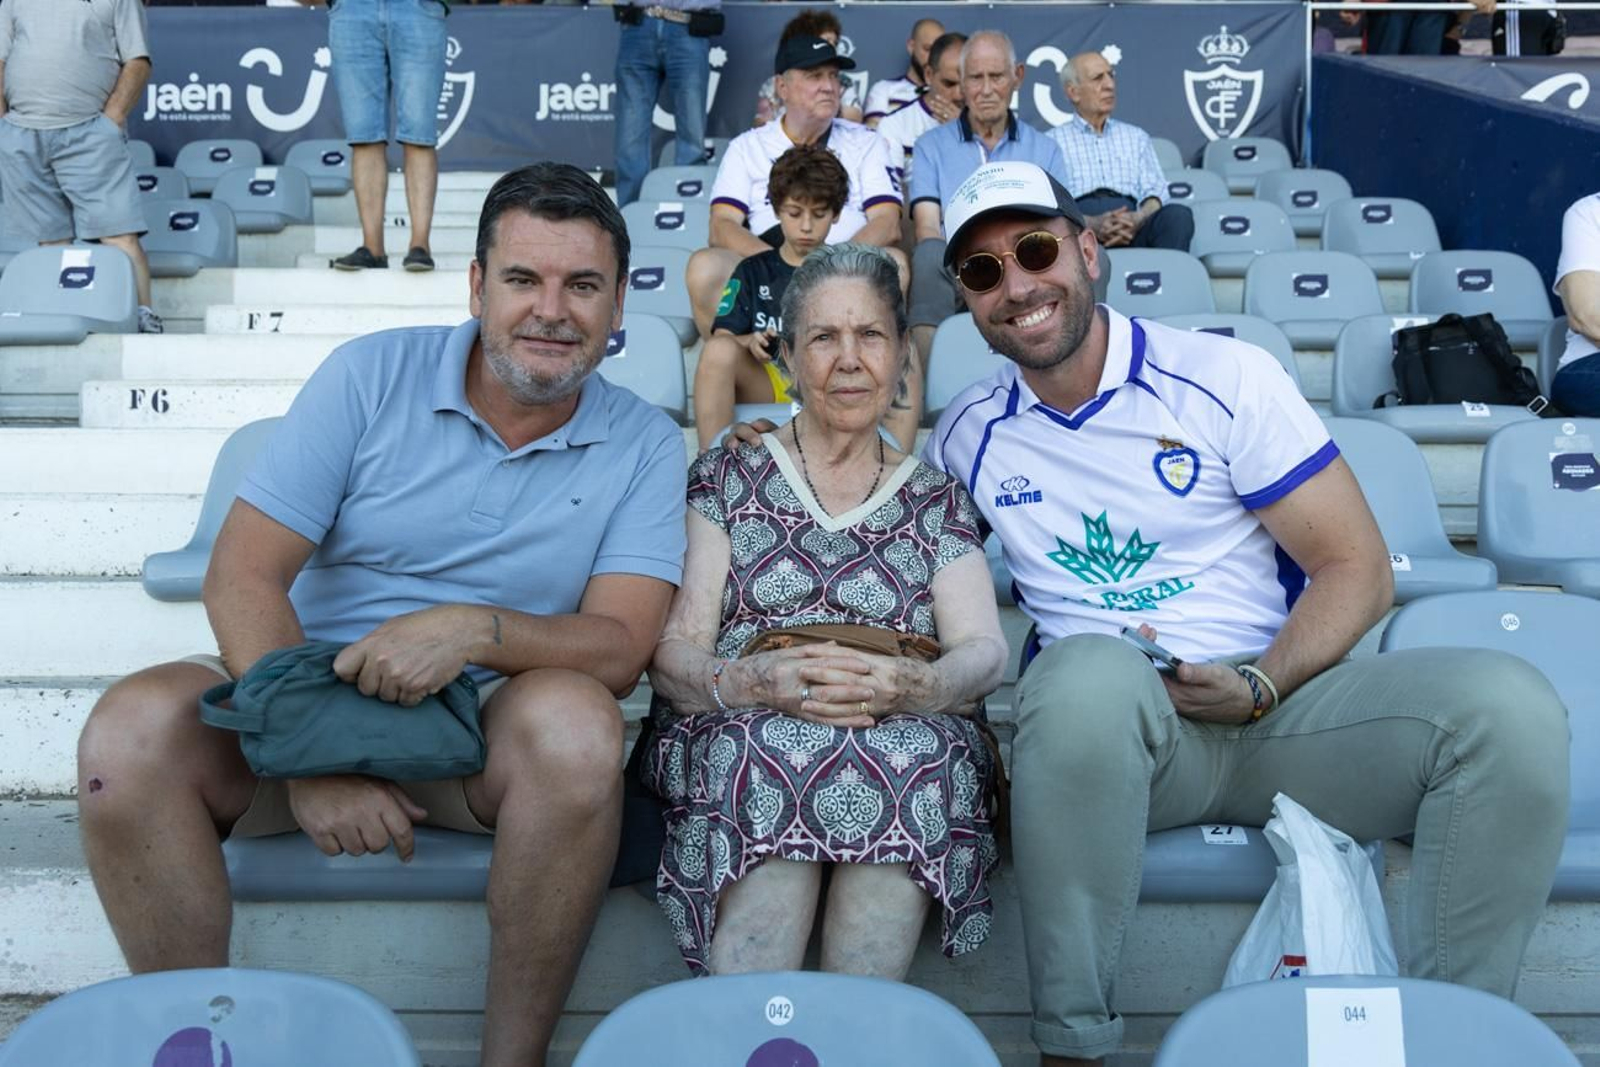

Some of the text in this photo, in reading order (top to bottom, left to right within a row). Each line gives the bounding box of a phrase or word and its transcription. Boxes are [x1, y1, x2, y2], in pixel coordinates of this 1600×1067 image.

[995, 490, 1043, 508] KELME
[768, 1003, 791, 1019] 042
[1344, 1005, 1366, 1021] 044
